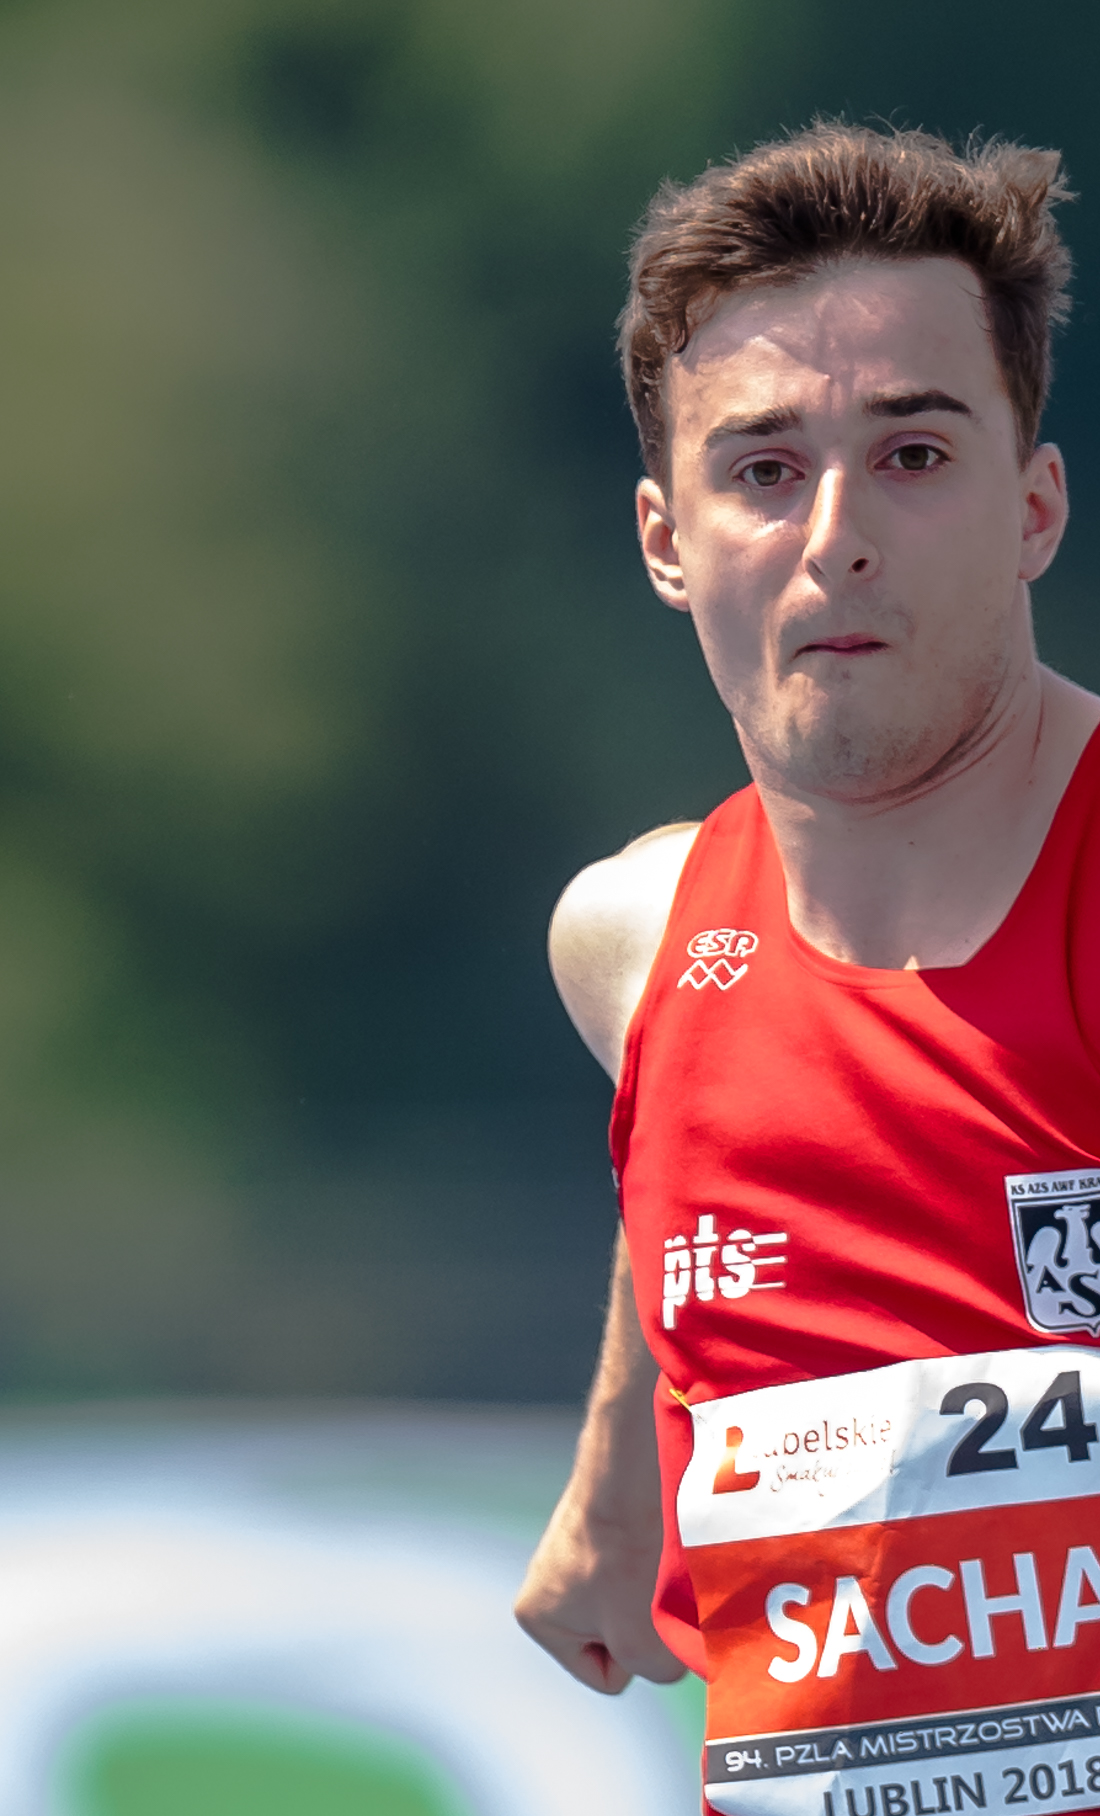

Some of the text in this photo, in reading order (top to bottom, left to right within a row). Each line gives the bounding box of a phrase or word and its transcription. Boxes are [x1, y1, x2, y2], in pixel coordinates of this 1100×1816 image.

[1010, 1184, 1025, 1196] KS
[1027, 1181, 1049, 1194] AZS
[662, 1214, 762, 1330] pts
[712, 1417, 891, 1495] Lbelskie
[725, 1748, 768, 1772] 94.
[775, 1741, 852, 1767] PZLA
[859, 1710, 1091, 1759] MISTRZOSTWA
